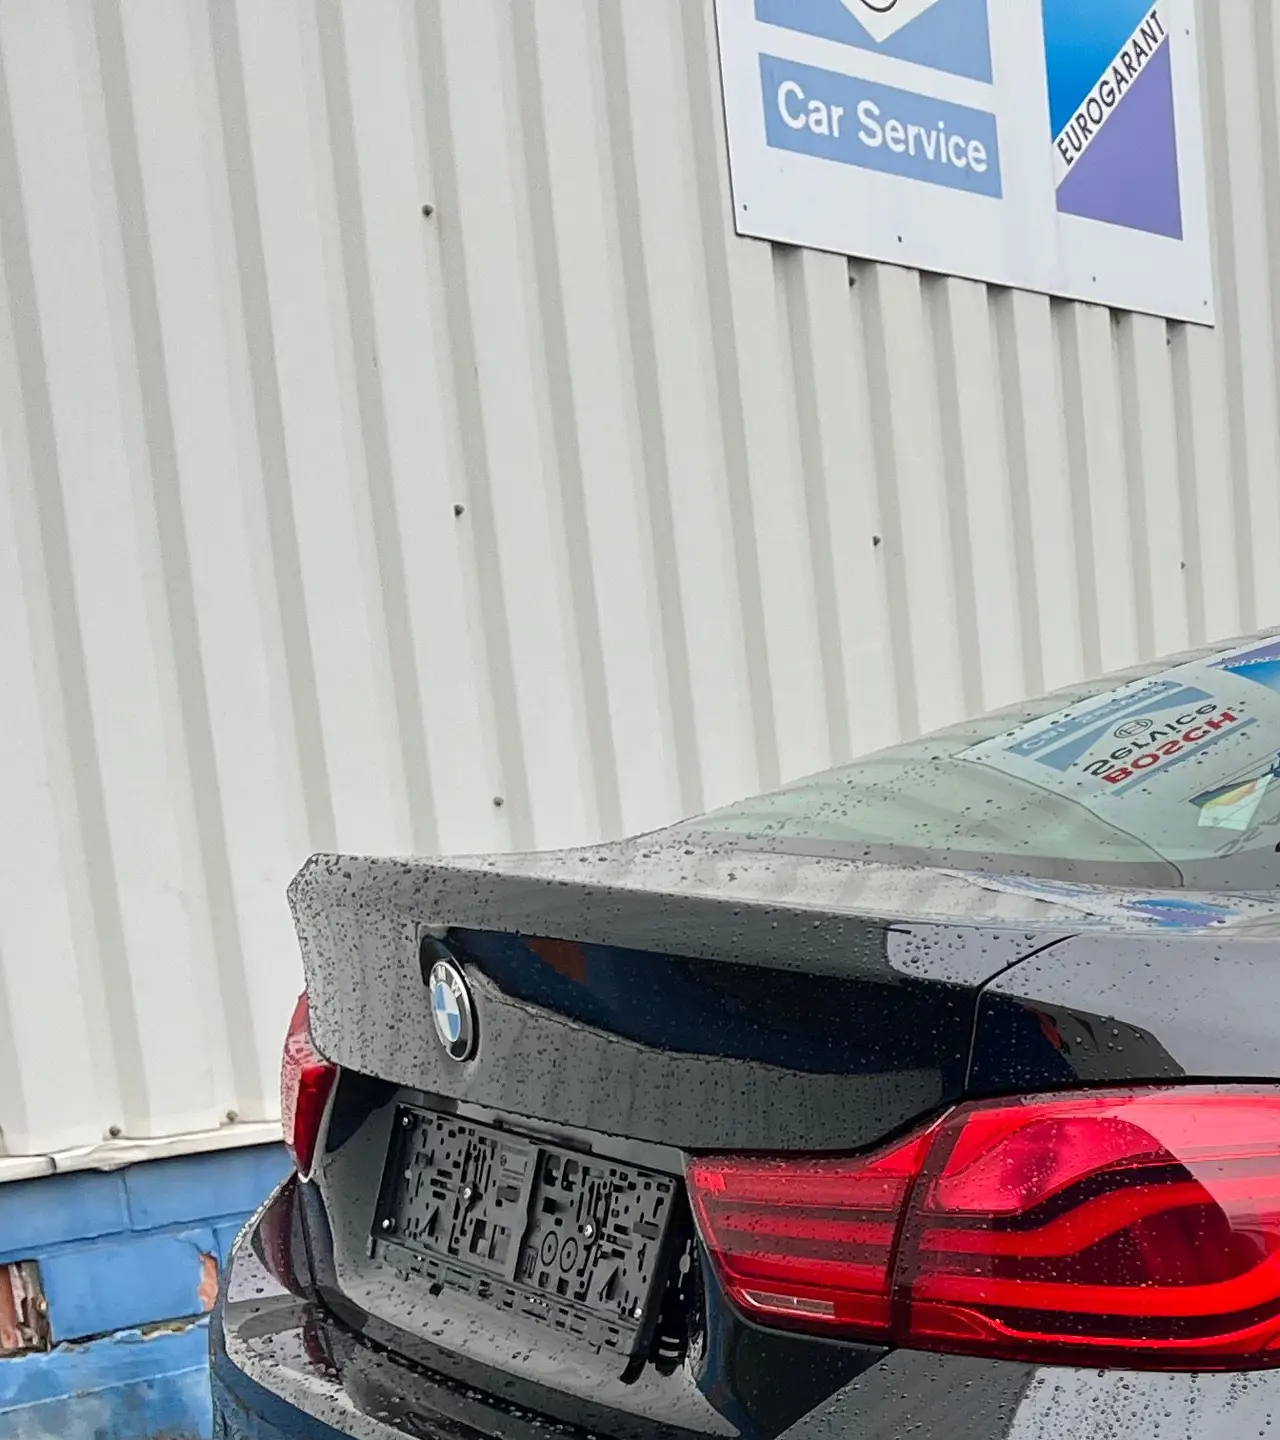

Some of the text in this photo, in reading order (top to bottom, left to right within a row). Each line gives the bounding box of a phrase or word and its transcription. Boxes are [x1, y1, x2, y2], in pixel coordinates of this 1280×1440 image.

[777, 80, 989, 173] Car Service
[1056, 9, 1166, 168] EUROGARANT
